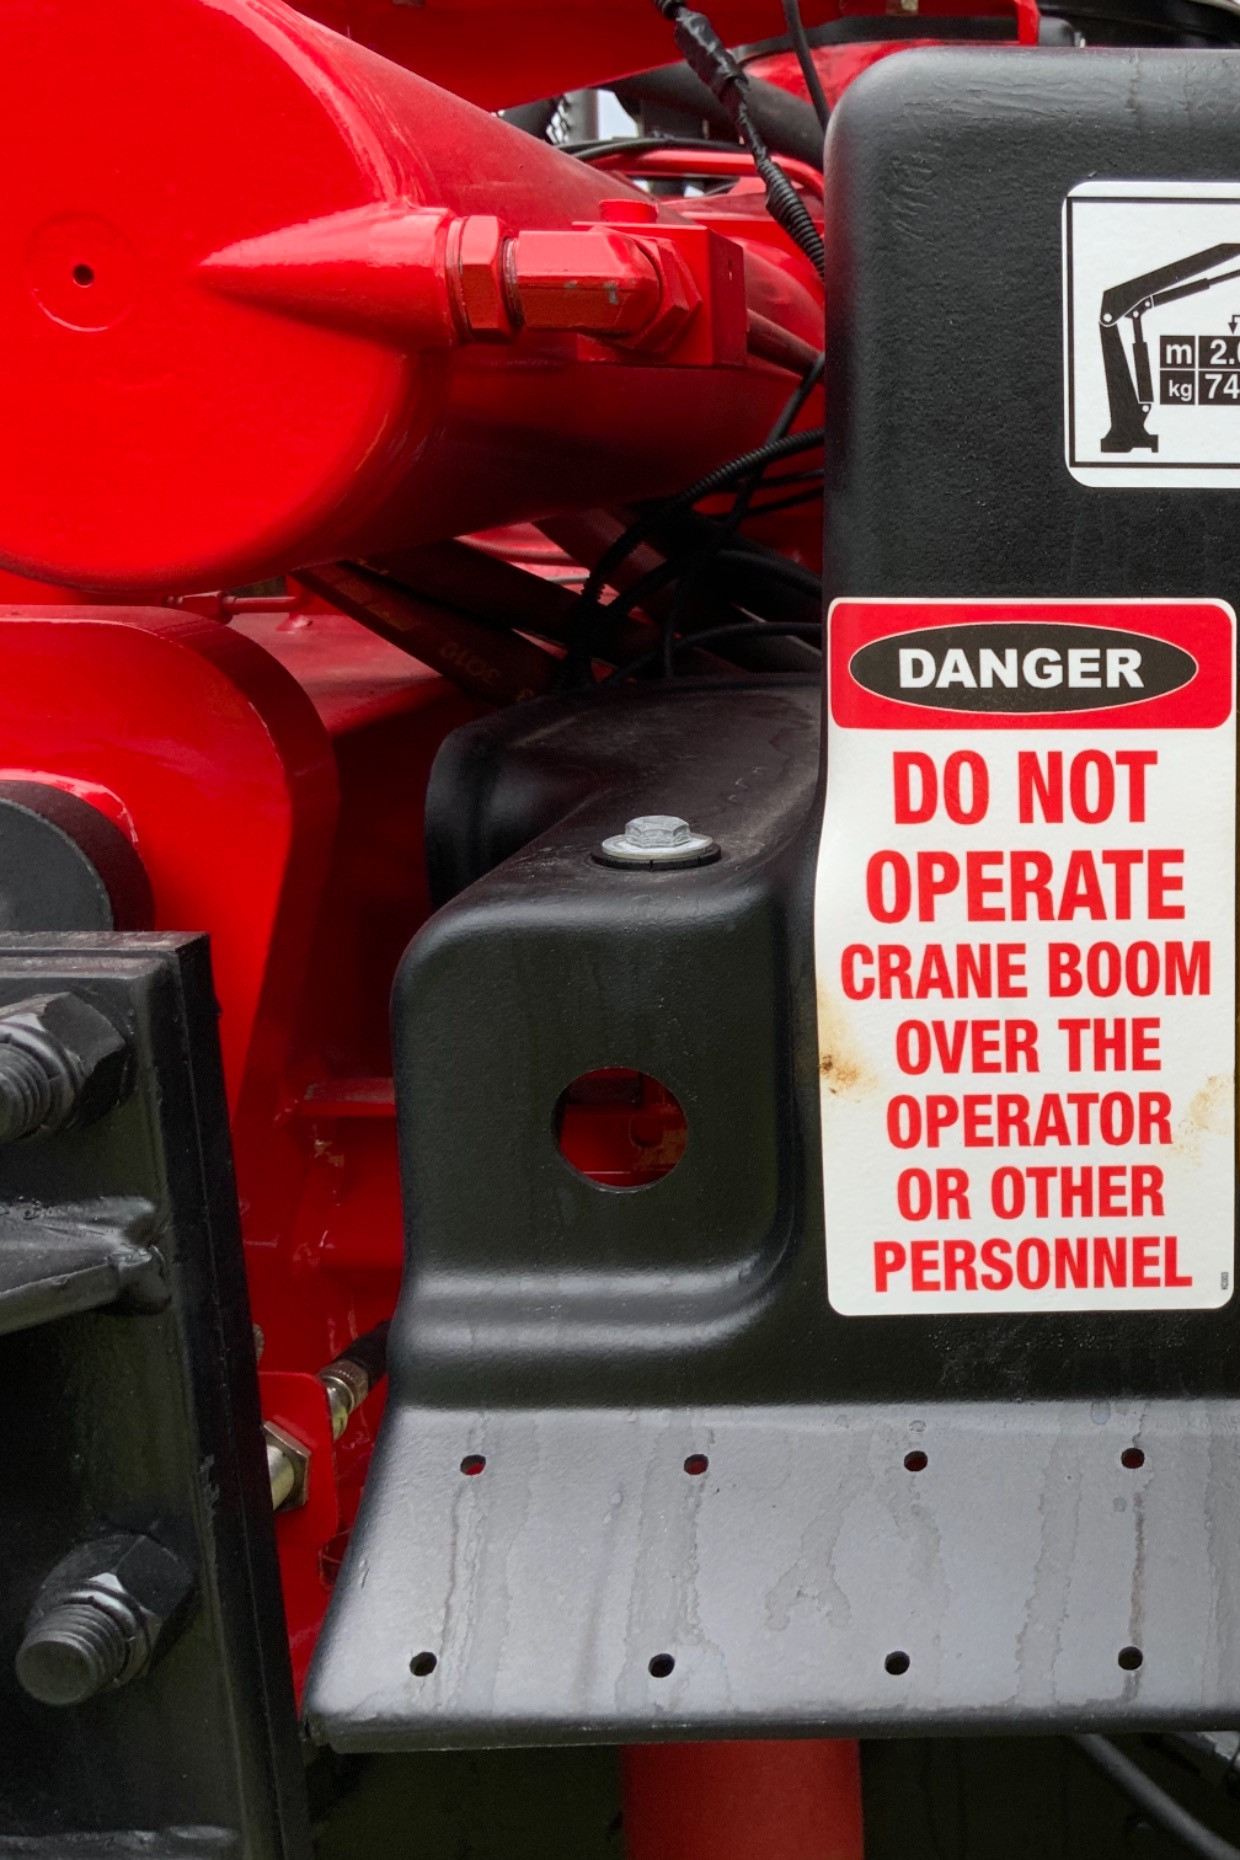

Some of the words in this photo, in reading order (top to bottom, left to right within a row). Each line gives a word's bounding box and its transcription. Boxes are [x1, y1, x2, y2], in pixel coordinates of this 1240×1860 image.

[1165, 342, 1193, 365] m
[1168, 379, 1193, 402] kg
[899, 648, 1145, 689] DANGER
[892, 749, 990, 825] DO
[1017, 748, 1158, 825] NOT
[866, 847, 1186, 925] OPERATE
[840, 943, 1029, 1001] CRANE
[1048, 940, 1211, 998] BOOM
[894, 1019, 1041, 1076] OVER
[1057, 1017, 1161, 1072] THE
[886, 1091, 1173, 1150] OPERATOR
[897, 1167, 972, 1222] OR
[990, 1165, 1166, 1220] OTHER
[873, 1236, 1193, 1293] PERSONNEL
